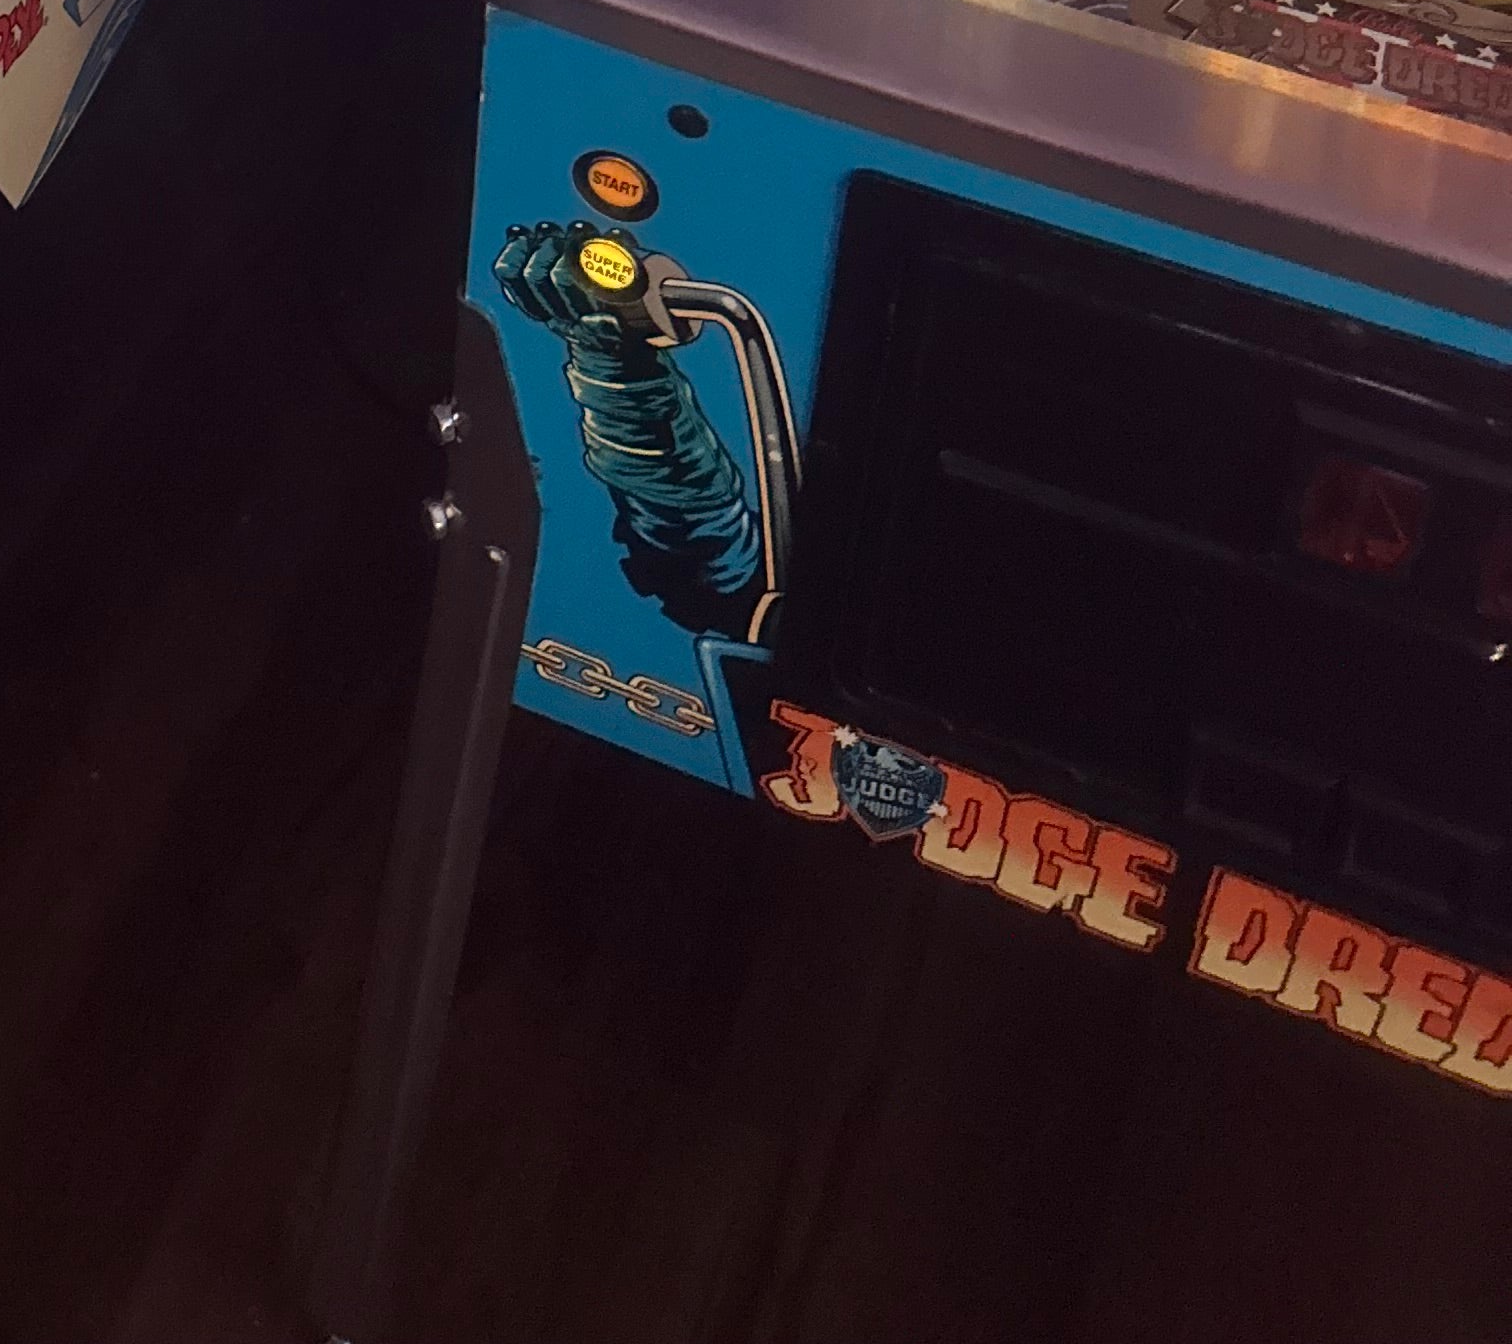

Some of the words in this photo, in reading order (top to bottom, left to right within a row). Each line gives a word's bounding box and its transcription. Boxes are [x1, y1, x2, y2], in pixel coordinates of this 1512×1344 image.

[592, 170, 639, 198] START
[583, 247, 633, 276] SUPER
[585, 261, 627, 285] GAME
[760, 698, 1178, 953] JDGE
